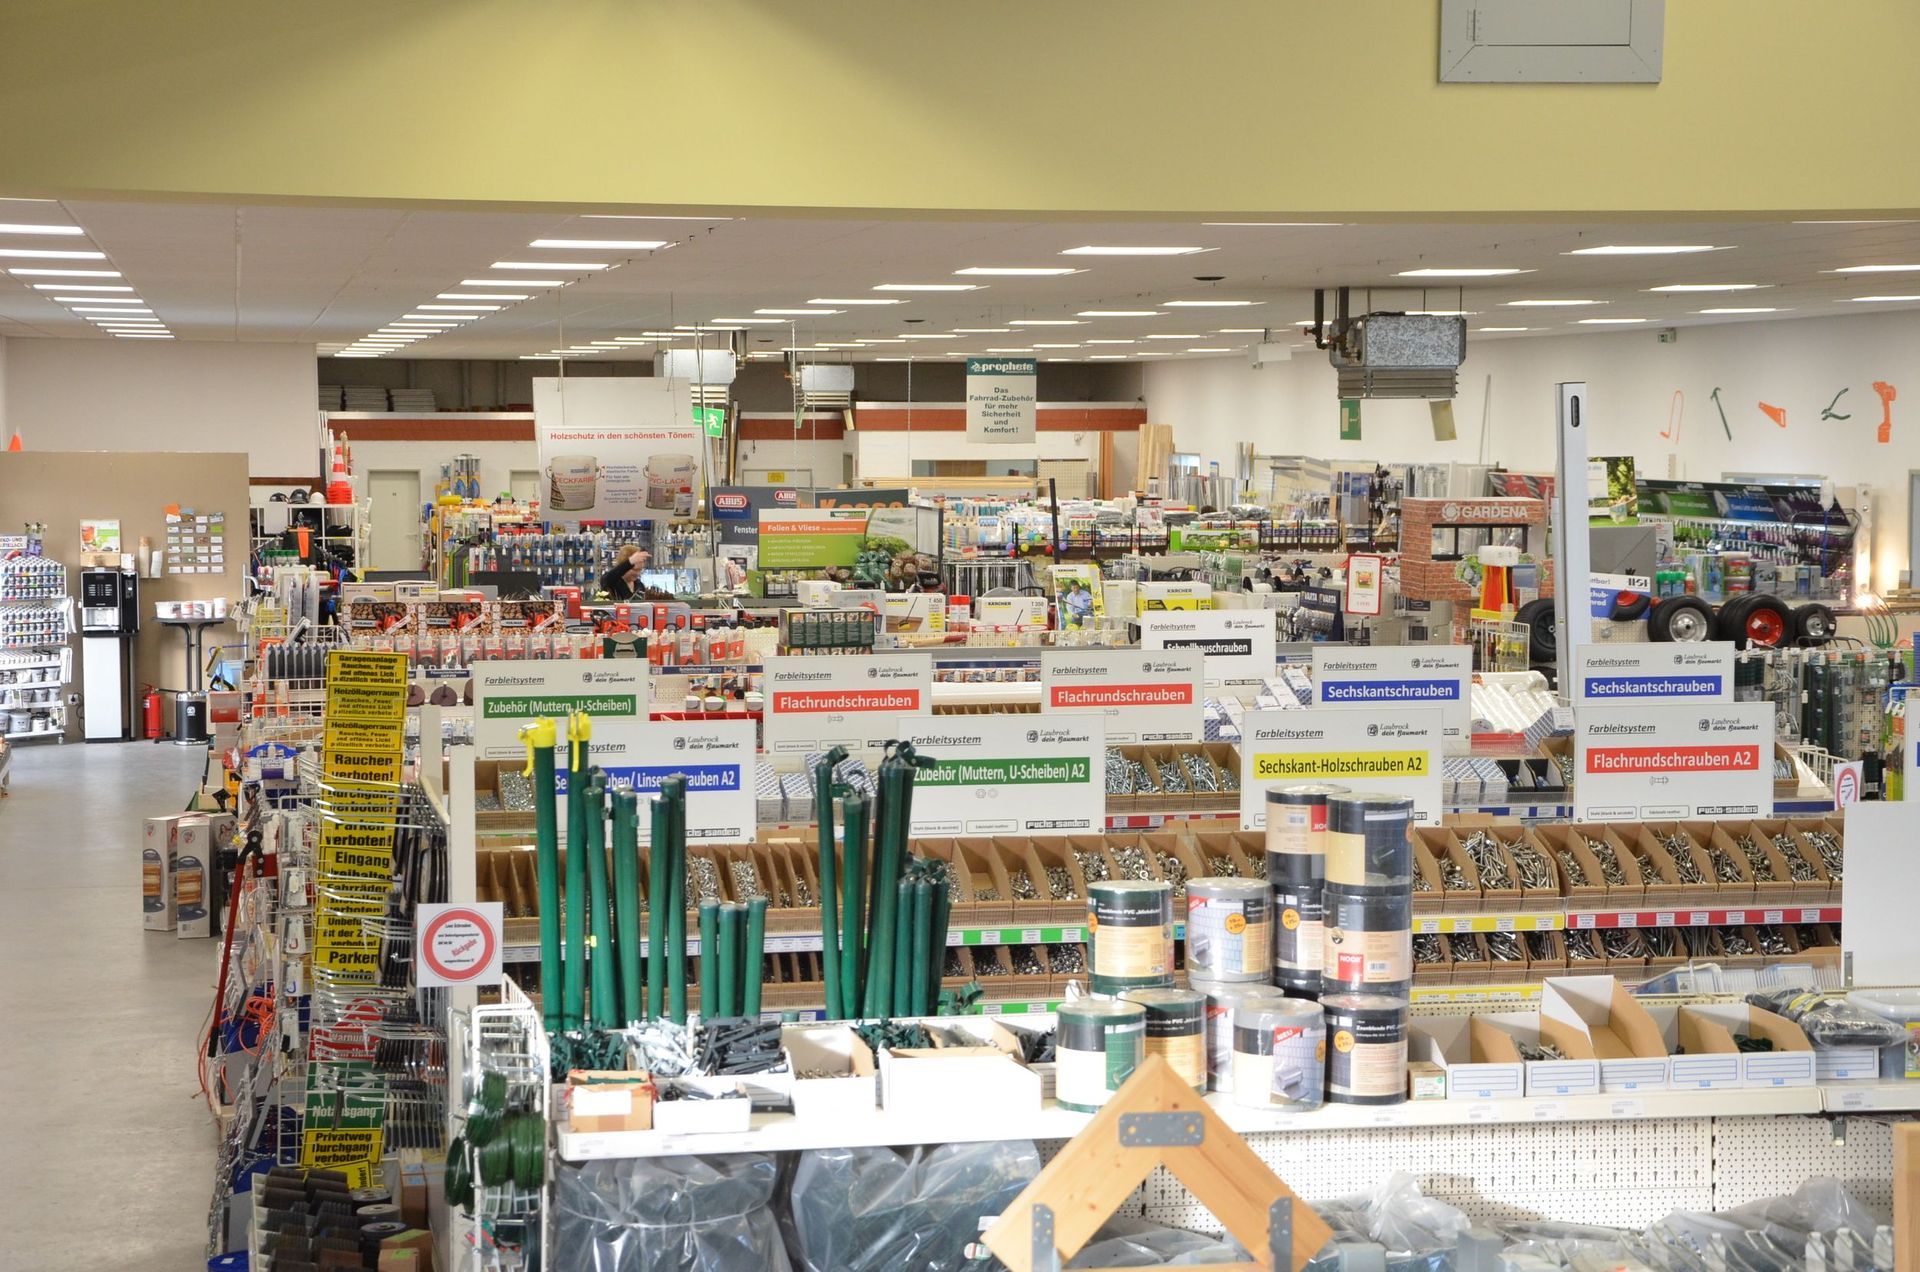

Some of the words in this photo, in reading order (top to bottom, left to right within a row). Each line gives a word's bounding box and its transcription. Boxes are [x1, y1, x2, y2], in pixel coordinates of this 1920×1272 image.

[982, 362, 1034, 372] prophete
[1462, 506, 1528, 518] GARDENA
[734, 526, 758, 534] Fenster
[339, 655, 398, 663] Garagenanlage
[1323, 662, 1377, 670] Farbleitsystem
[485, 676, 544, 686] Farbleitsystem
[774, 672, 832, 681] Farbleitsystem
[334, 688, 399, 697] Heizöllagerraum
[1328, 685, 1453, 698] Sechskantschrauben
[1591, 680, 1715, 694] Sechskantschrauben
[781, 694, 912, 708] Flachrundschrauben
[1058, 689, 1185, 703] Flachrundschrauben
[488, 701, 527, 713] Zubehör
[530, 700, 574, 714] (Muttern,
[577, 699, 631, 713] U-Scheiben)
[331, 722, 396, 730] Heizöllagerraum
[1589, 724, 1656, 734] Farbleitsystem
[1256, 729, 1324, 738] Farbleitsystem
[911, 736, 981, 745] Farbleitsystem
[335, 754, 393, 766] Rauchen
[1259, 758, 1403, 774] Sechskant-Holzschrauben
[1407, 757, 1422, 771] A2
[1594, 753, 1729, 769] Flachrundschrauben
[1733, 751, 1751, 765] A2
[332, 770, 394, 781] verboten!
[914, 767, 957, 781] Zubehör
[959, 765, 1007, 783] (Muttern,
[1010, 763, 1069, 781] U-Scheiben)
[1072, 764, 1085, 778] A2
[637, 772, 718, 788] Linserauben
[721, 771, 735, 785] A2
[335, 819, 385, 831] Parken
[326, 835, 392, 846] verboten!
[336, 852, 390, 868] Eingang
[328, 918, 385, 926] Unbefuten
[338, 929, 354, 937] der
[329, 951, 378, 964] Parken
[1276, 1028, 1293, 1040] NEU
[313, 1106, 376, 1119] Notsgang
[315, 1133, 372, 1142] Privatweg
[312, 1143, 373, 1152] Durchgang
[315, 1153, 368, 1163] verboten!
